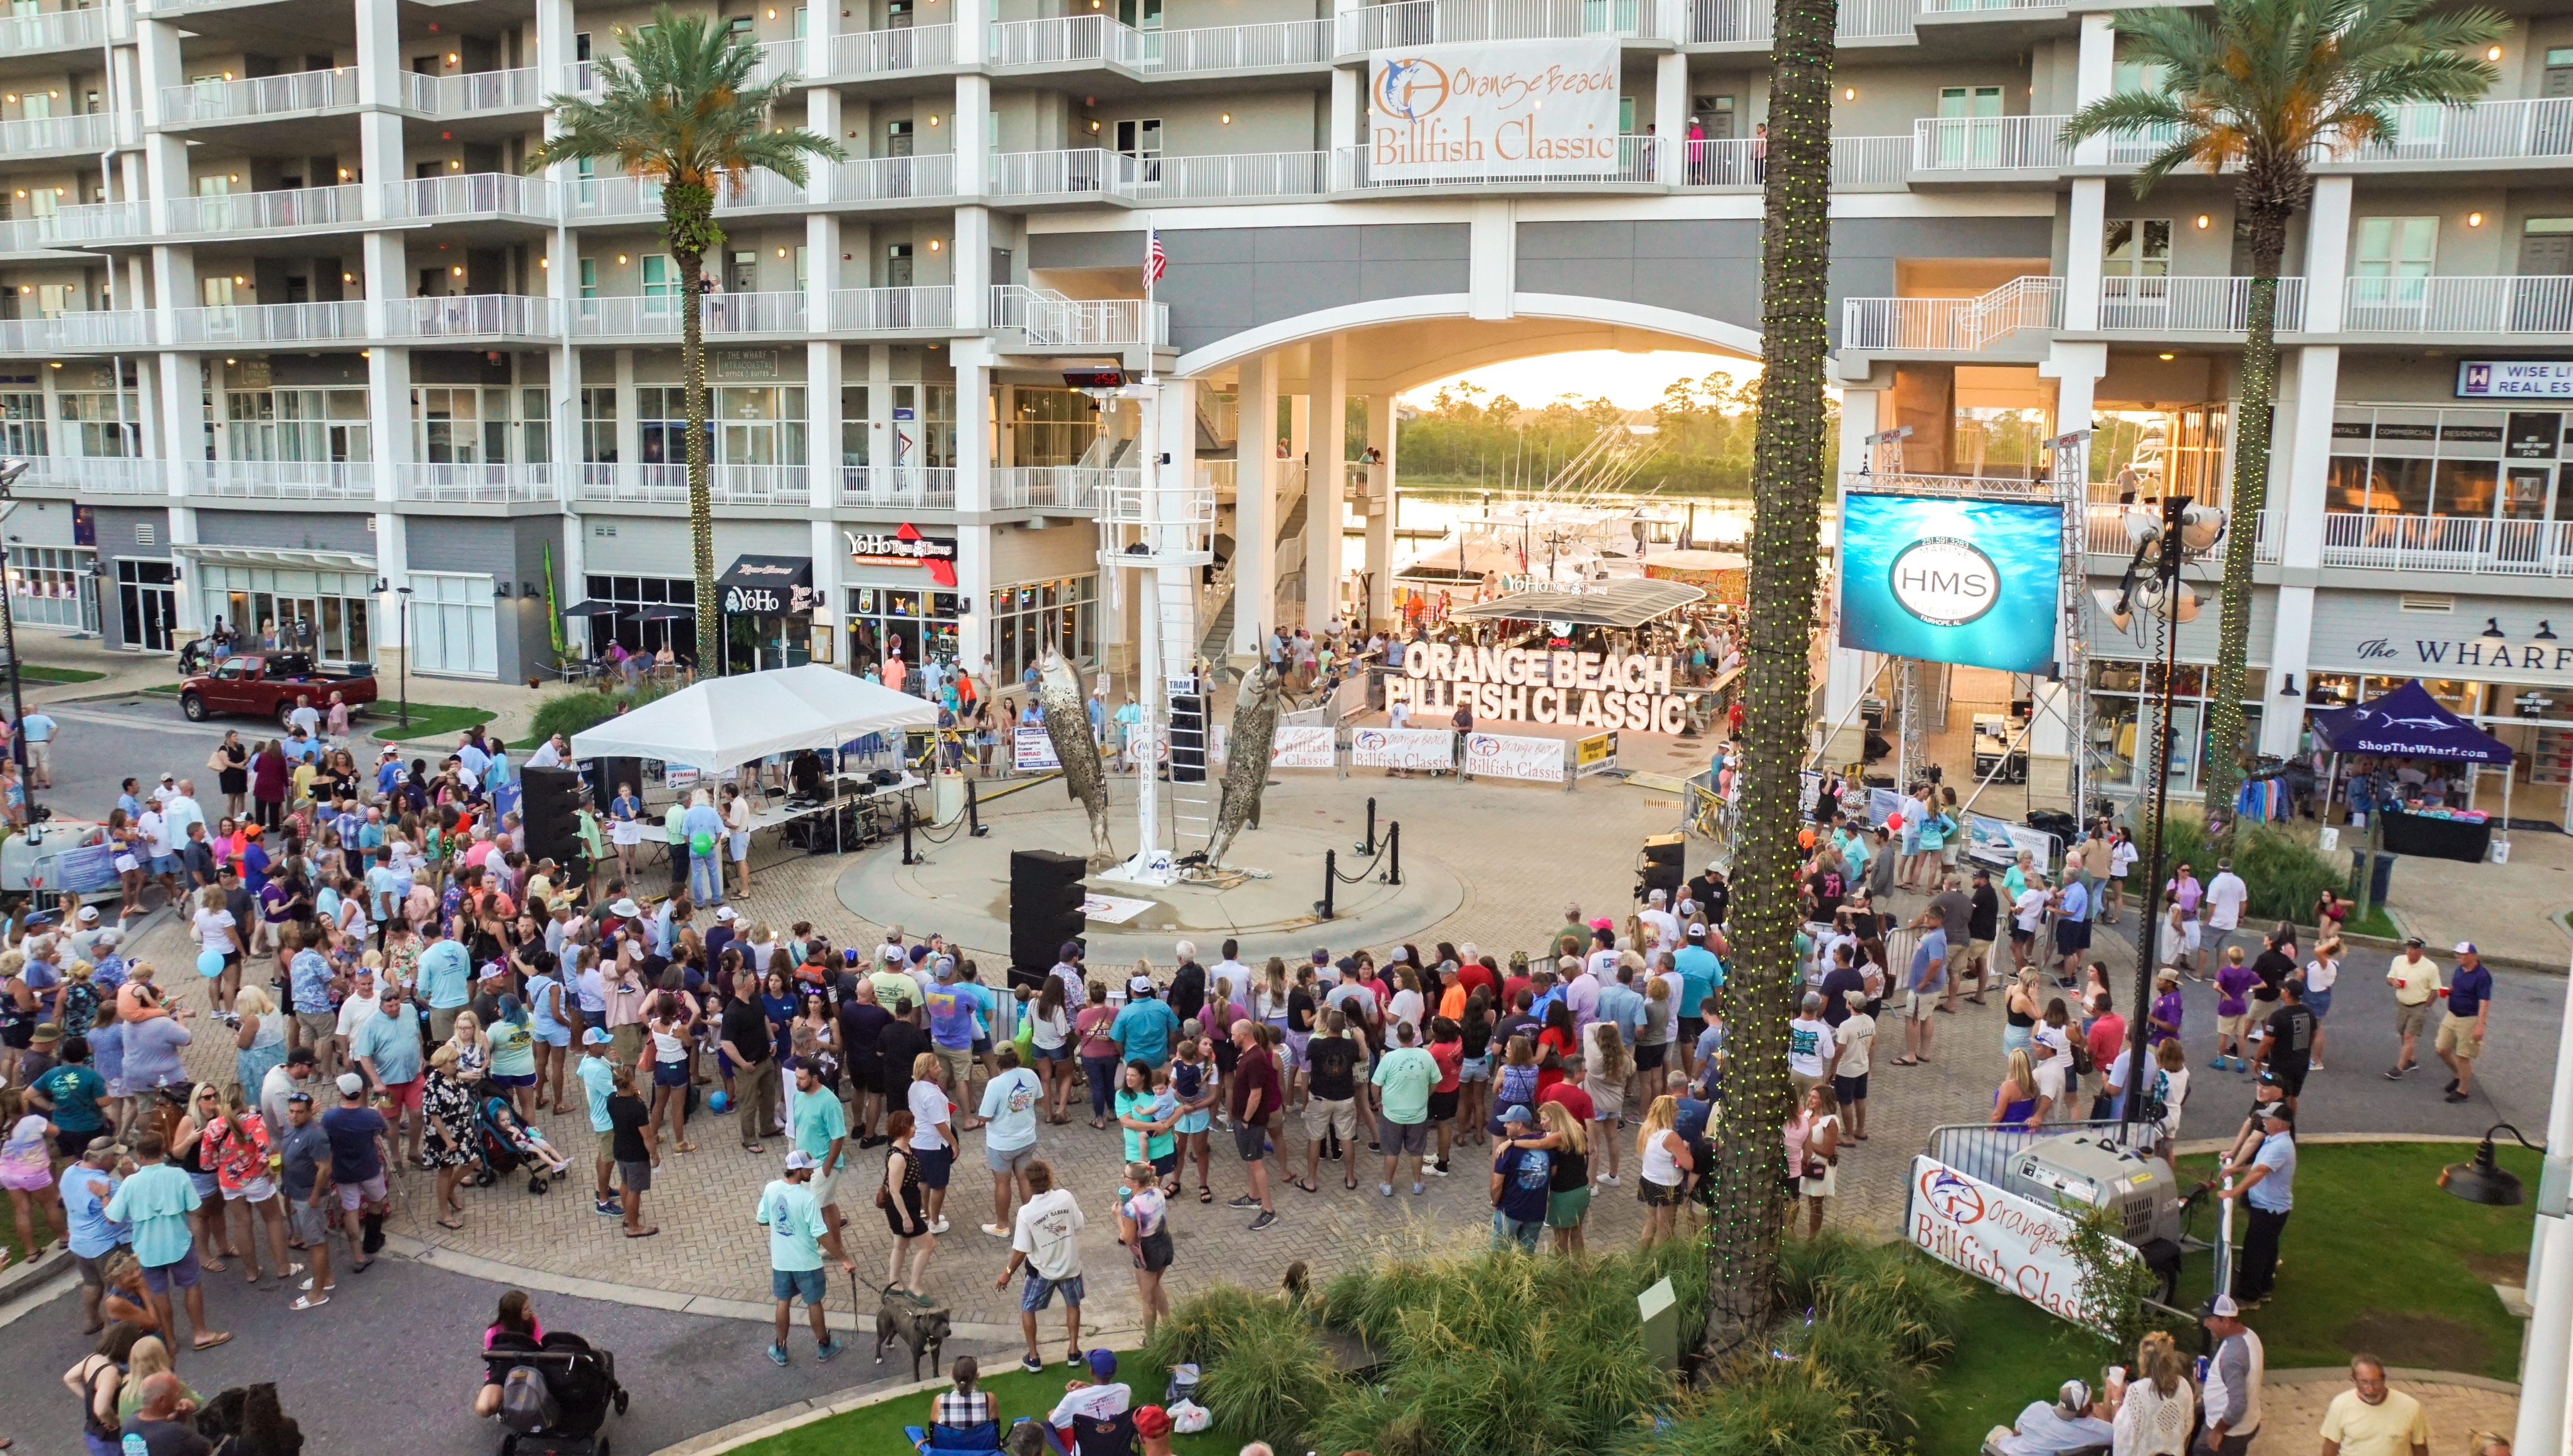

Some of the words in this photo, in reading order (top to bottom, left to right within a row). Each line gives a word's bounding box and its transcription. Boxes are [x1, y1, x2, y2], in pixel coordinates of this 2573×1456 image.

[1453, 66, 1544, 110] Orange
[1547, 64, 1613, 96] Beach
[1374, 115, 1485, 165] Billfish
[1495, 113, 1614, 160] Classic
[728, 352, 740, 360] THE
[2508, 366, 2549, 377] WISE
[2556, 367, 2573, 377] LI
[2499, 382, 2543, 393] REAL
[2550, 382, 2573, 393] ES
[1922, 537, 1969, 548] 251.591.3283
[1920, 545, 1971, 560] MARINE
[1902, 568, 1987, 597] HMS
[1913, 600, 1972, 617] ELECTRIC
[1920, 615, 1952, 626] FAIRHOPE,
[1549, 638, 1570, 646] OPEN
[2357, 638, 2399, 659] The
[2416, 641, 2573, 669] WHARF
[1405, 641, 1549, 687] ORANGE
[1552, 651, 1673, 695] BEACH
[1169, 681, 1190, 689] TRAM
[1386, 677, 1527, 722] BILLFISH
[1532, 686, 1686, 735] CLASSIC
[1292, 727, 1325, 742] Beach
[1387, 734, 1419, 750] Orange
[1421, 733, 1448, 746] Beach
[1285, 740, 1330, 753] Billfish
[1502, 741, 1533, 758] Orange
[1534, 743, 1560, 755] Beach
[2358, 740, 2488, 758] ShopTheWharf.com
[1285, 754, 1329, 766] Classic
[1355, 753, 1400, 768] Billfish
[1404, 753, 1449, 768] Classic
[1469, 757, 1513, 775] Billfish
[1517, 762, 1561, 779] Classic
[2011, 835, 2044, 847] EXPECTATIONS
[2015, 832, 2041, 842] EXCEEDING
[1824, 880, 1840, 897] 21
[2034, 1198, 2056, 1213] United
[1988, 1200, 2059, 1255] Orange
[1916, 1213, 2007, 1285] Billfish
[2016, 1265, 2079, 1322] Clas
